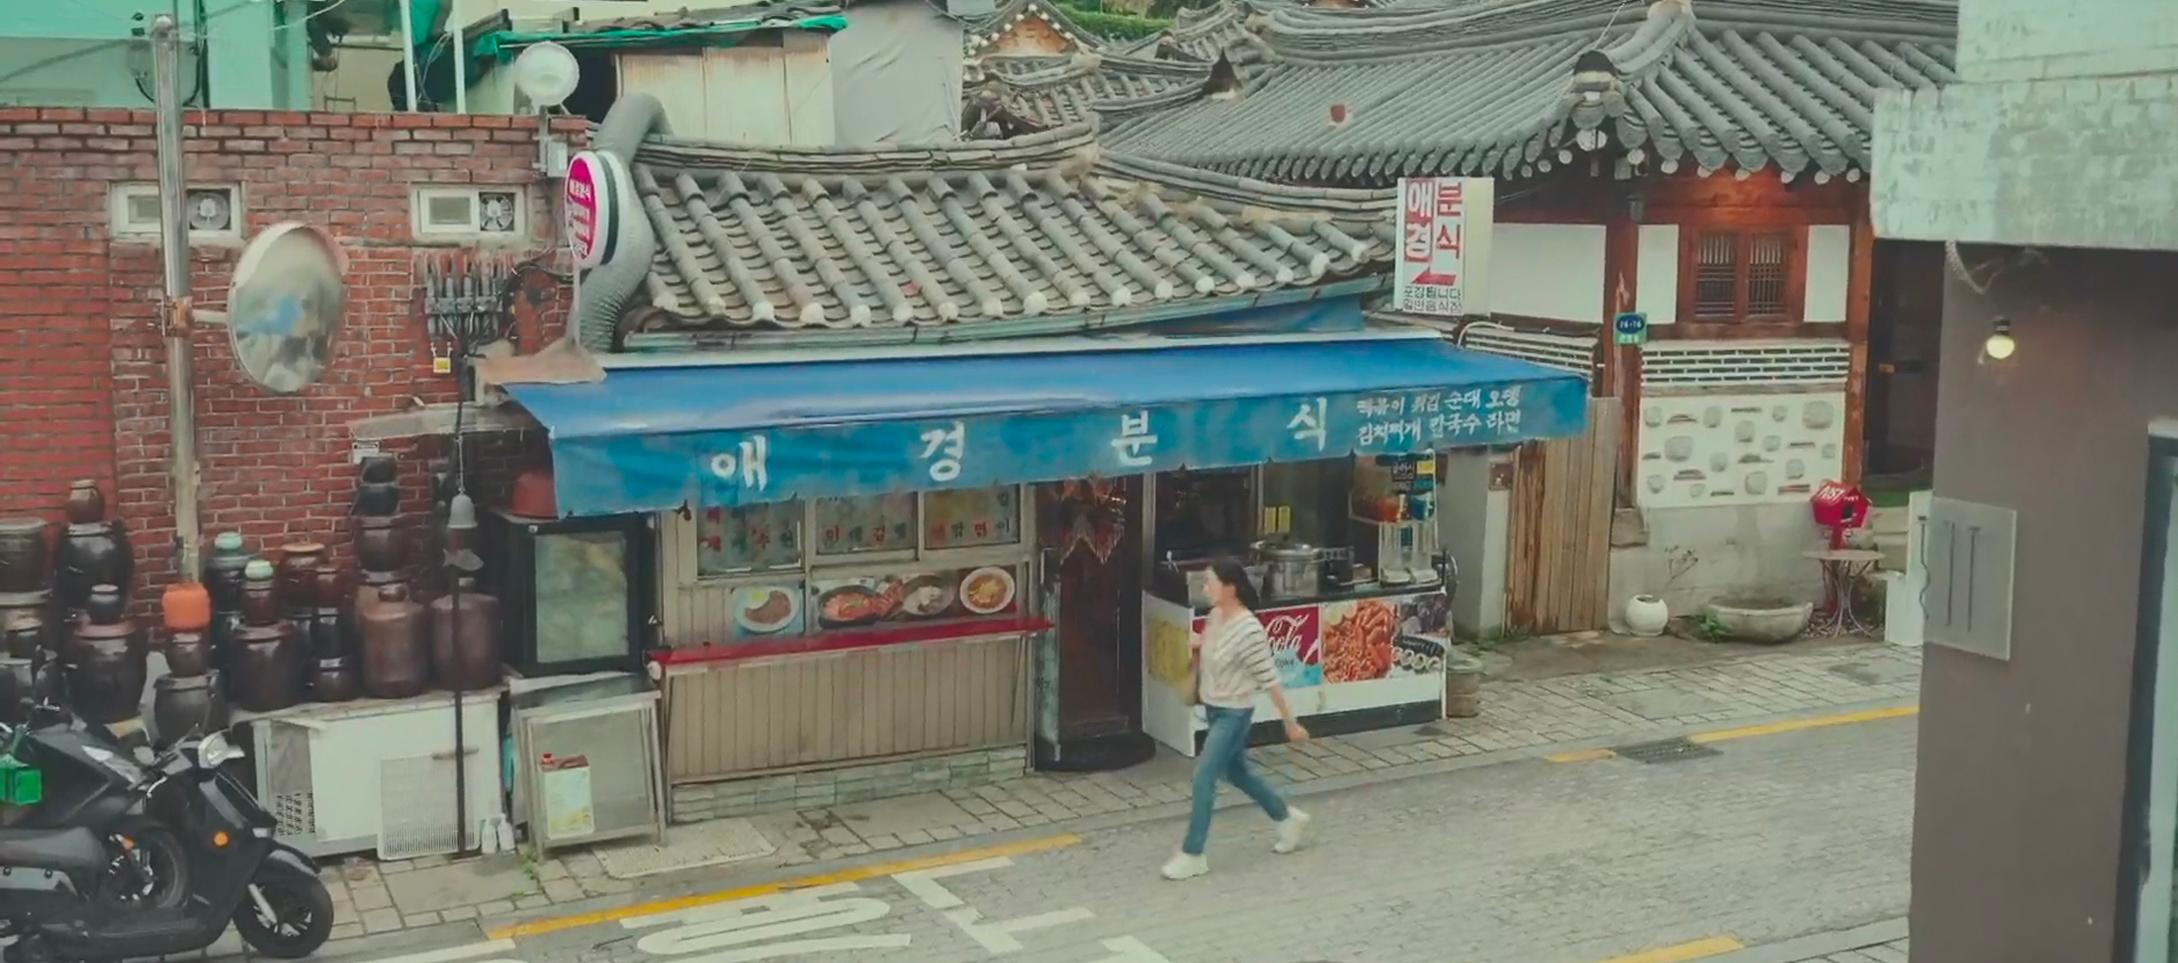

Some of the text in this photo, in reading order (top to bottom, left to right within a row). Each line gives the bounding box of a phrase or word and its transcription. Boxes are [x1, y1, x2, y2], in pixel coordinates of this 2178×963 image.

[1406, 181, 1433, 258] 애경
[1437, 182, 1462, 260] 분식
[1444, 388, 1482, 410] 순대
[1485, 384, 1523, 409] 오뎅
[1357, 417, 1422, 446] 김치찌개
[1486, 409, 1521, 435] 라면
